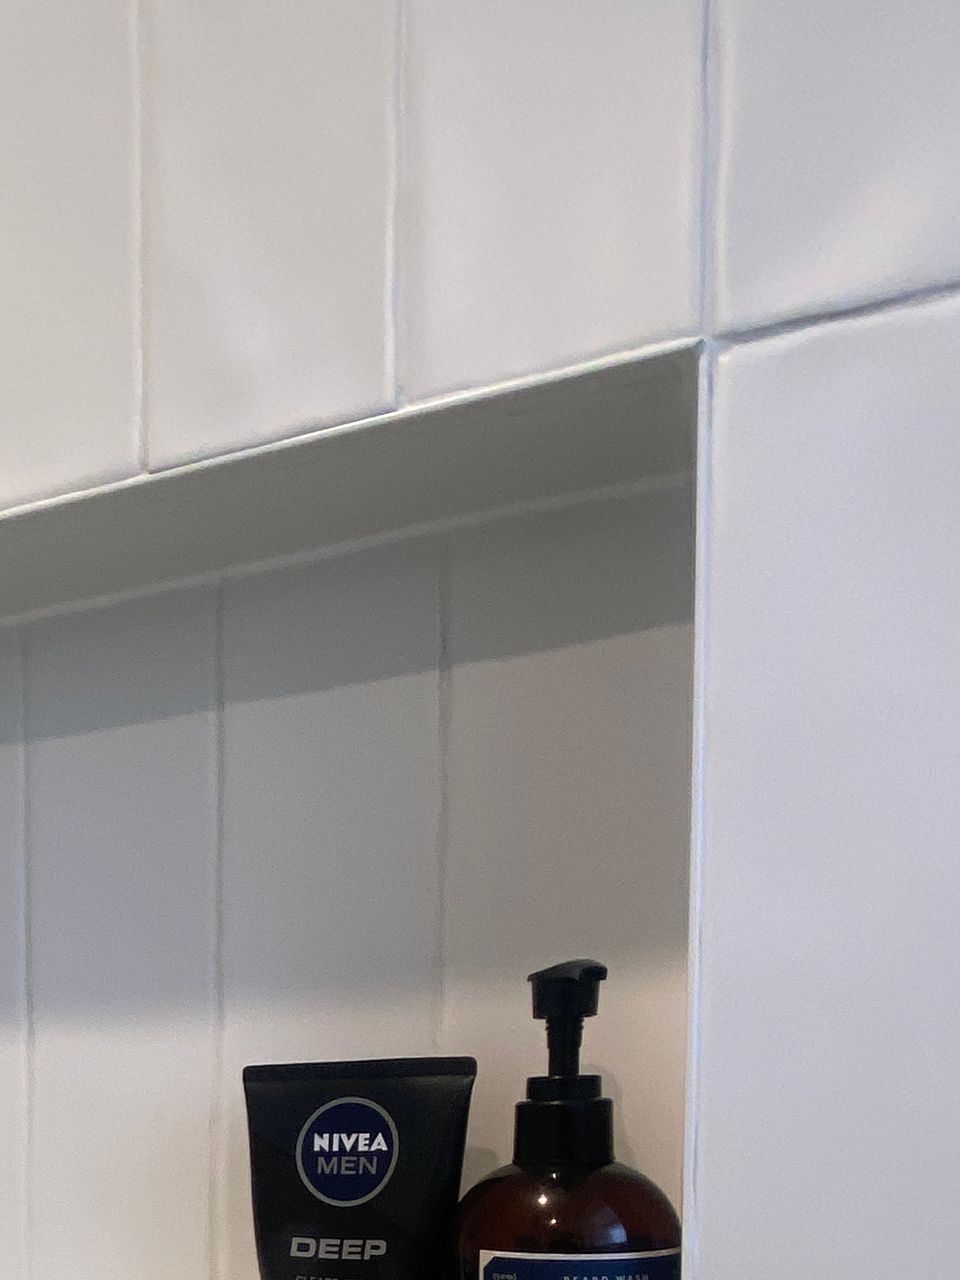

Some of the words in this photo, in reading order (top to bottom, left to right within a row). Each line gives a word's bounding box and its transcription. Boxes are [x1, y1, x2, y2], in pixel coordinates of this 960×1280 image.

[313, 1132, 388, 1152] NIVEA
[317, 1156, 378, 1175] MEN
[290, 1237, 387, 1260] DEEP
